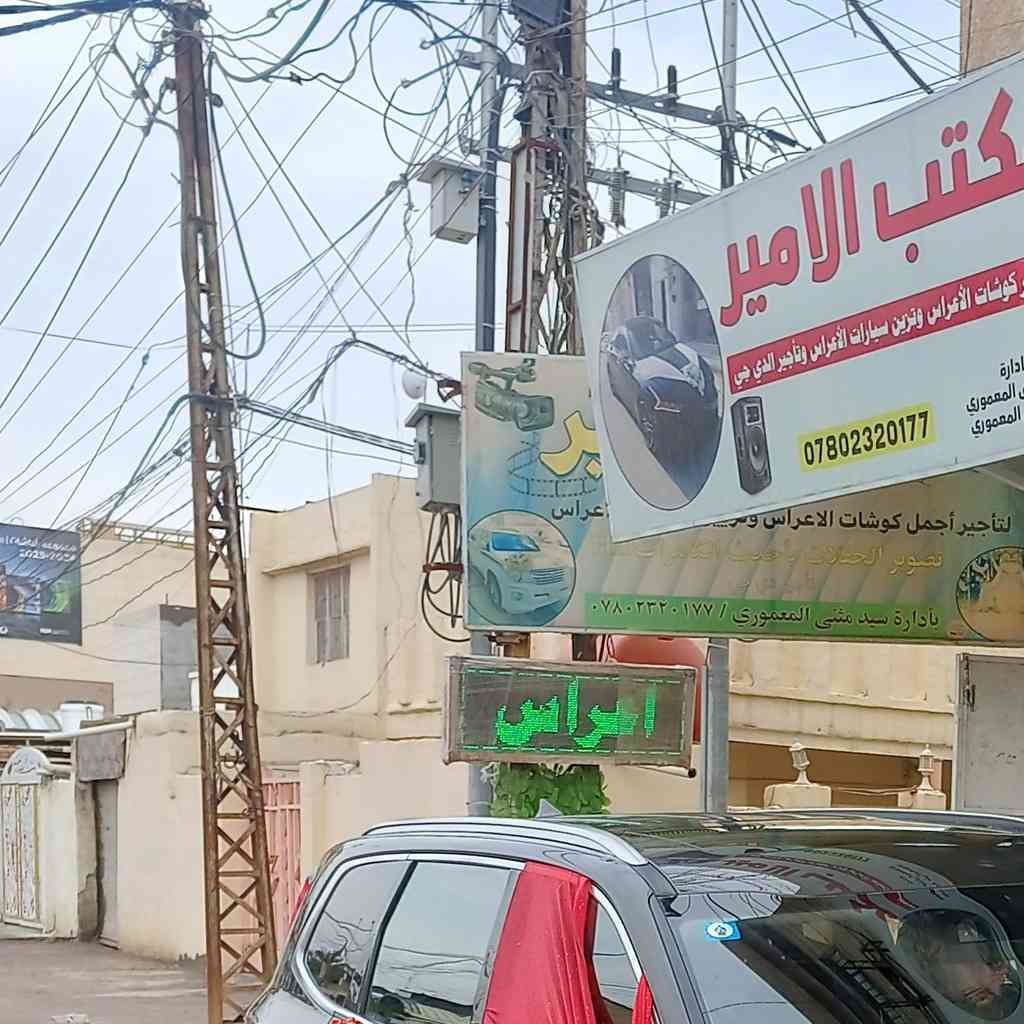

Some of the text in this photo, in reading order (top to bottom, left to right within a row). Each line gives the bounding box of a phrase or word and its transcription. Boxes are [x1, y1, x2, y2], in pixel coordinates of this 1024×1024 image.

[720, 158, 861, 327] الامير
[975, 272, 1017, 305] كوشات
[850, 320, 889, 346] سيارات
[734, 365, 751, 390] جي
[752, 352, 774, 383] الدي
[966, 382, 1016, 416] المعموري
[971, 405, 1021, 438] المعموري
[804, 411, 929, 465] 07802320177
[763, 509, 834, 530] الاعراس
[838, 510, 901, 533] كوشات
[906, 511, 954, 536] أجمل
[956, 515, 1011, 537] لتأجير
[732, 607, 810, 628] المعموري
[815, 608, 852, 629] مثنى
[858, 613, 889, 628] سيد
